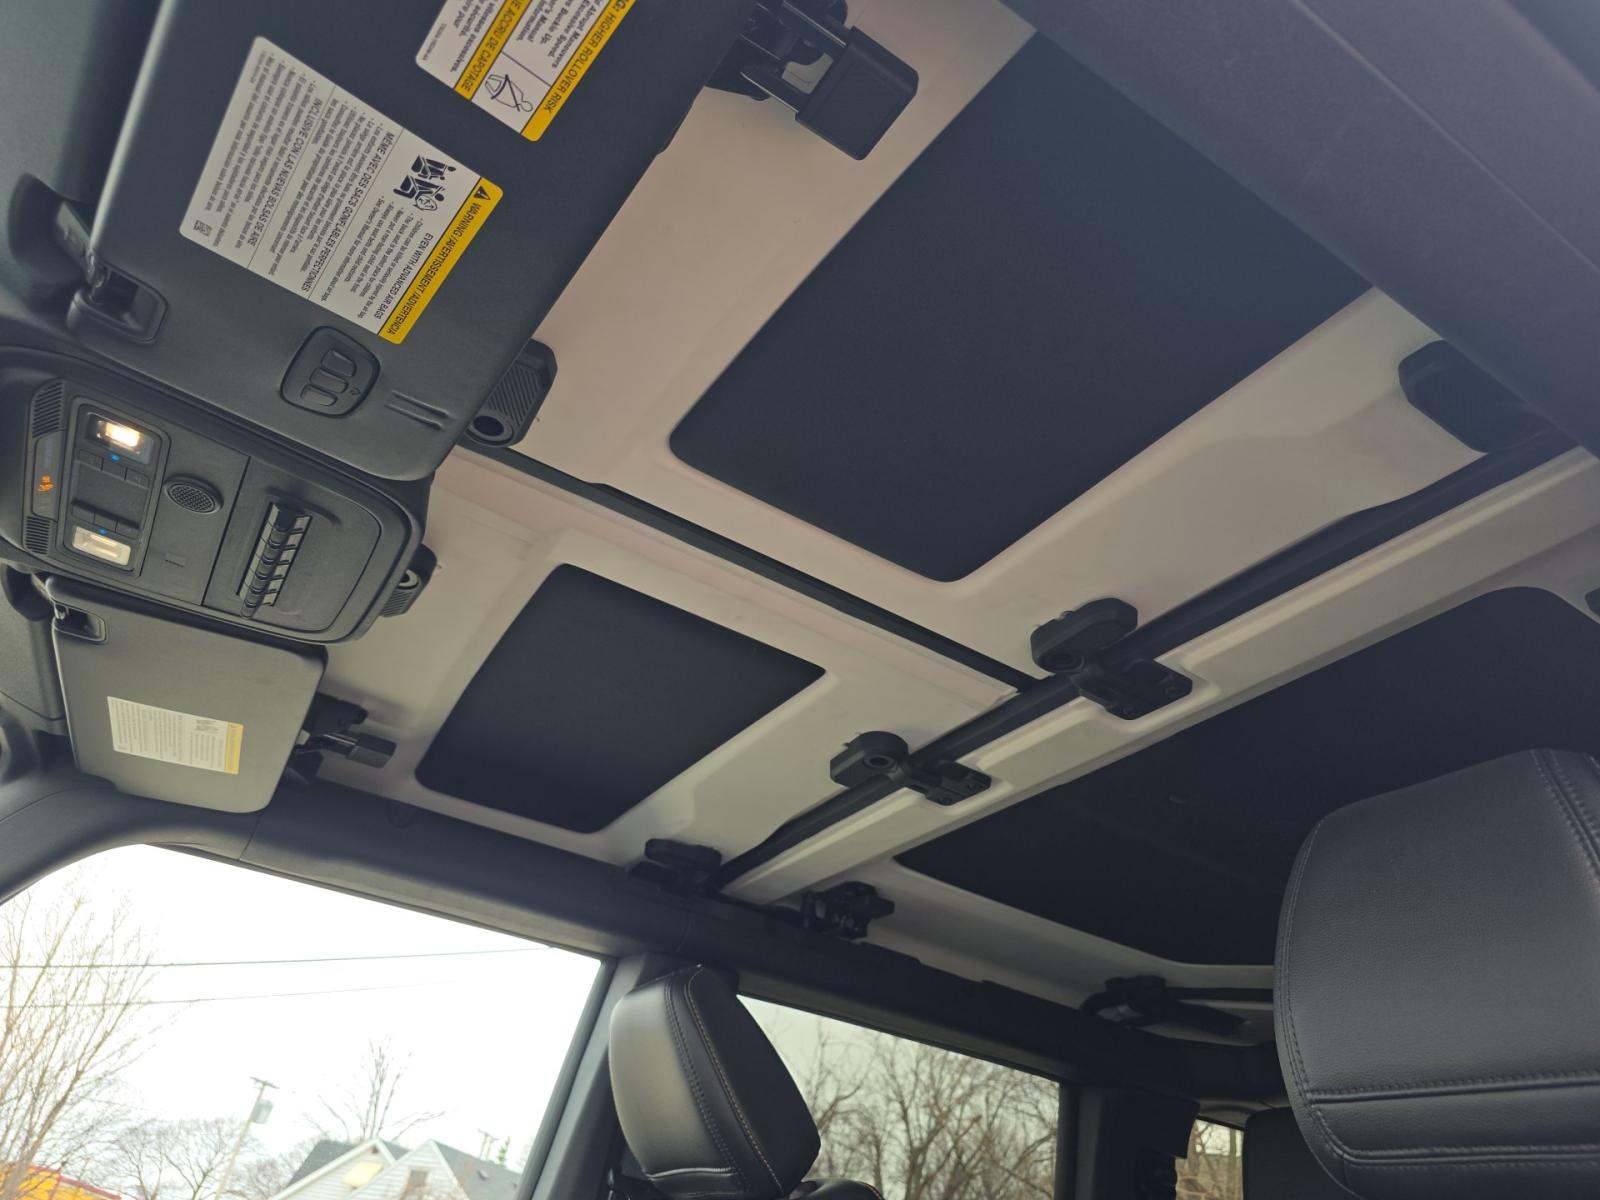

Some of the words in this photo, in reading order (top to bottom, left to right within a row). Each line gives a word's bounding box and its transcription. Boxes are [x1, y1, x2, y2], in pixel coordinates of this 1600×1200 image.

[588, 12, 616, 48] HIGHER
[486, 36, 498, 49] DE
[460, 49, 490, 91] CAPOTAGE
[556, 46, 592, 94] ROLLOVER
[543, 91, 562, 113] RISK
[297, 97, 323, 138] INCLUSIVE
[289, 136, 305, 155] CON
[283, 152, 297, 170] LAS
[365, 152, 383, 175] AVEC
[270, 167, 290, 197] NUEVAS
[357, 171, 373, 189] DES
[347, 186, 365, 208] SACS
[257, 194, 277, 223] BOLSAS
[451, 200, 481, 237] WARNING
[253, 220, 265, 232] DE
[324, 205, 354, 249] GONFLABLES
[246, 229, 260, 247] AIRE
[416, 231, 433, 251] EVEN
[407, 248, 423, 266] WITH
[388, 263, 413, 295] ADVANCED
[382, 292, 395, 305] AIR
[373, 302, 388, 319] BAGS
